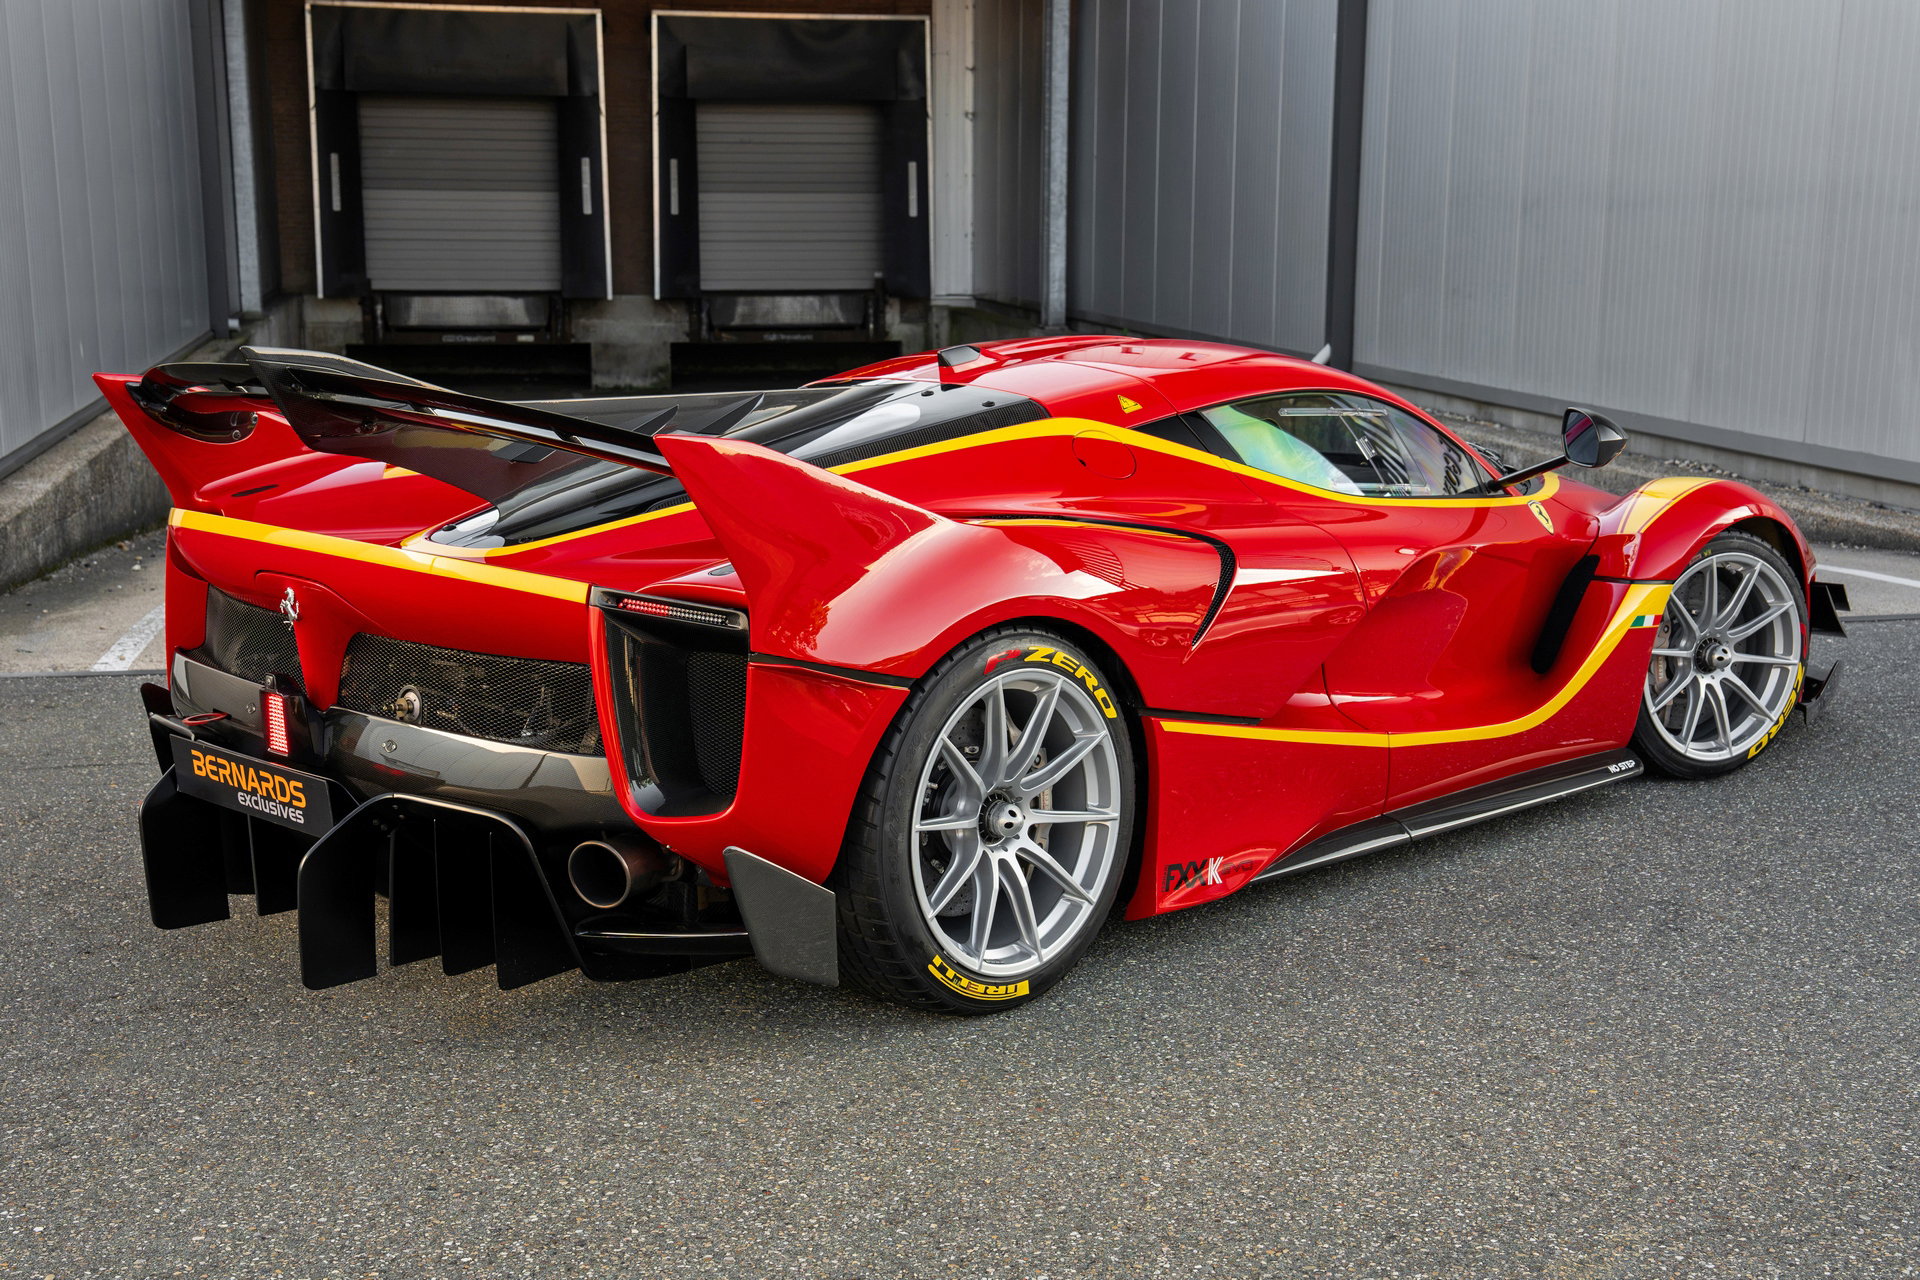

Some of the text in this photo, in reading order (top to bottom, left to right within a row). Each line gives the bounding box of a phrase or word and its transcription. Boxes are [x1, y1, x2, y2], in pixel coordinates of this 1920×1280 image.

[1024, 646, 1118, 719] ZERO
[1747, 661, 1805, 759] ZERO
[191, 749, 307, 808] BERNARDS
[1607, 764, 1620, 774] NO
[237, 791, 304, 824] exclusives
